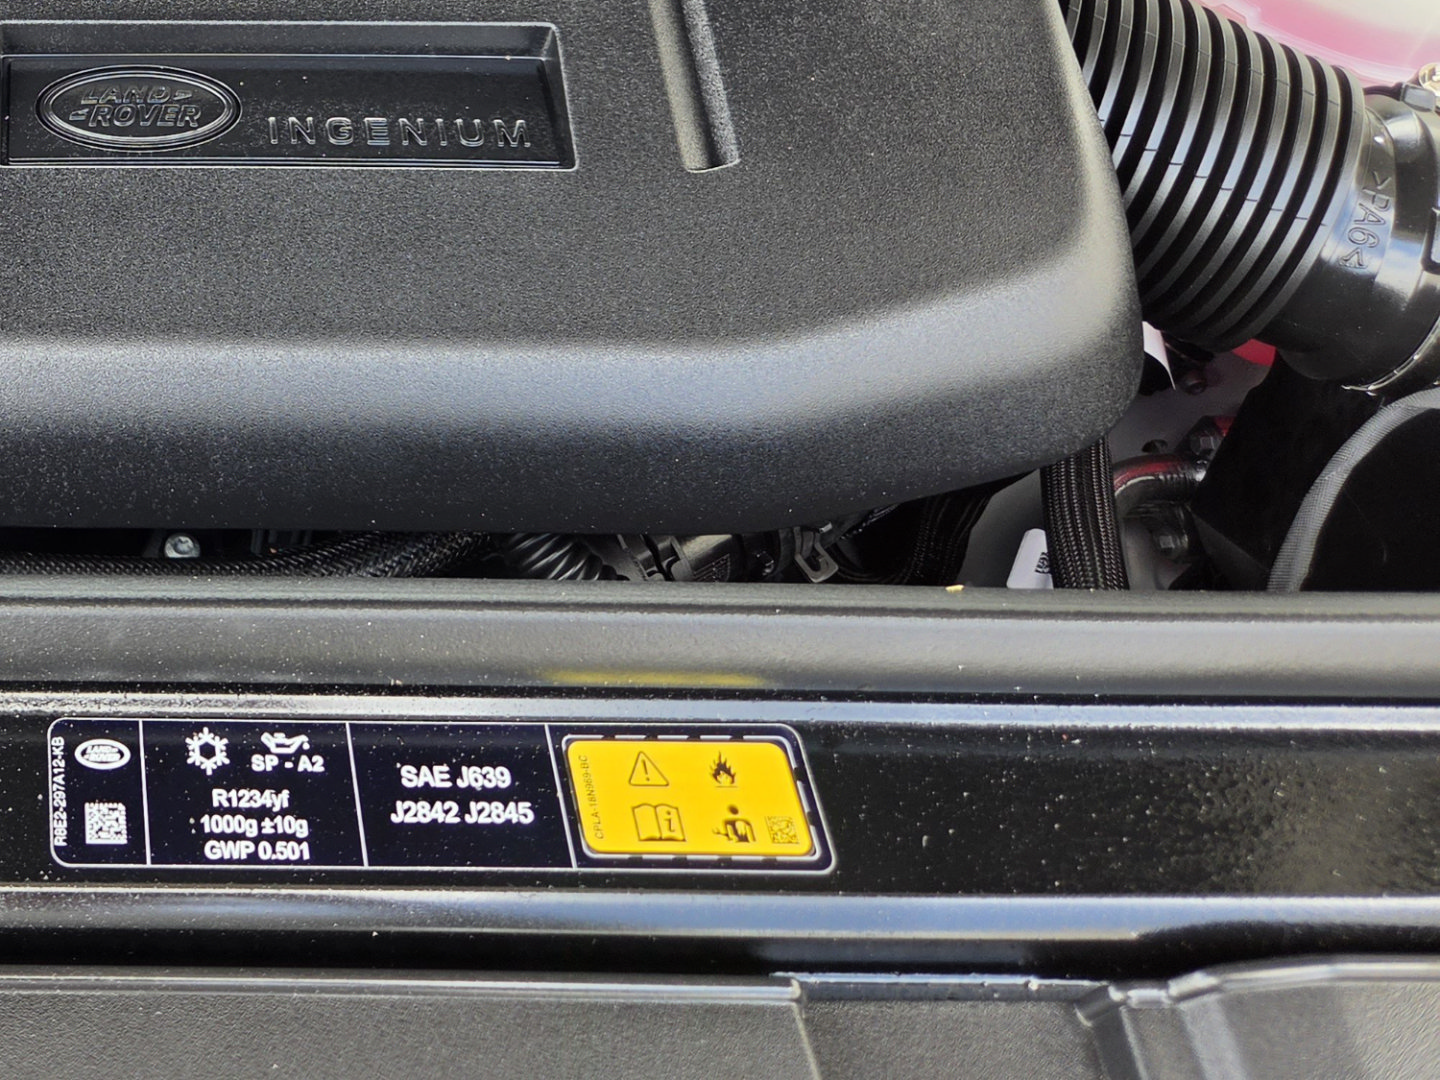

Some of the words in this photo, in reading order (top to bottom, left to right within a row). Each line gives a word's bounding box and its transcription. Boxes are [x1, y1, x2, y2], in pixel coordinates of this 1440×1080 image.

[81, 86, 173, 104] LAND
[86, 104, 202, 128] ROVER
[267, 116, 531, 148] INGENIUM
[251, 754, 279, 771] SP
[297, 755, 325, 772] A2
[400, 765, 453, 788] SAE
[456, 765, 512, 789] J639
[51, 736, 68, 847] R8E2-297A12-KB
[212, 788, 290, 812] R1234yf
[390, 800, 460, 824] J2842
[464, 800, 535, 825] J2845
[200, 814, 258, 838] 1000g
[261, 815, 309, 838] ±10g
[204, 840, 256, 859] GWP
[258, 841, 310, 860] 0.501
